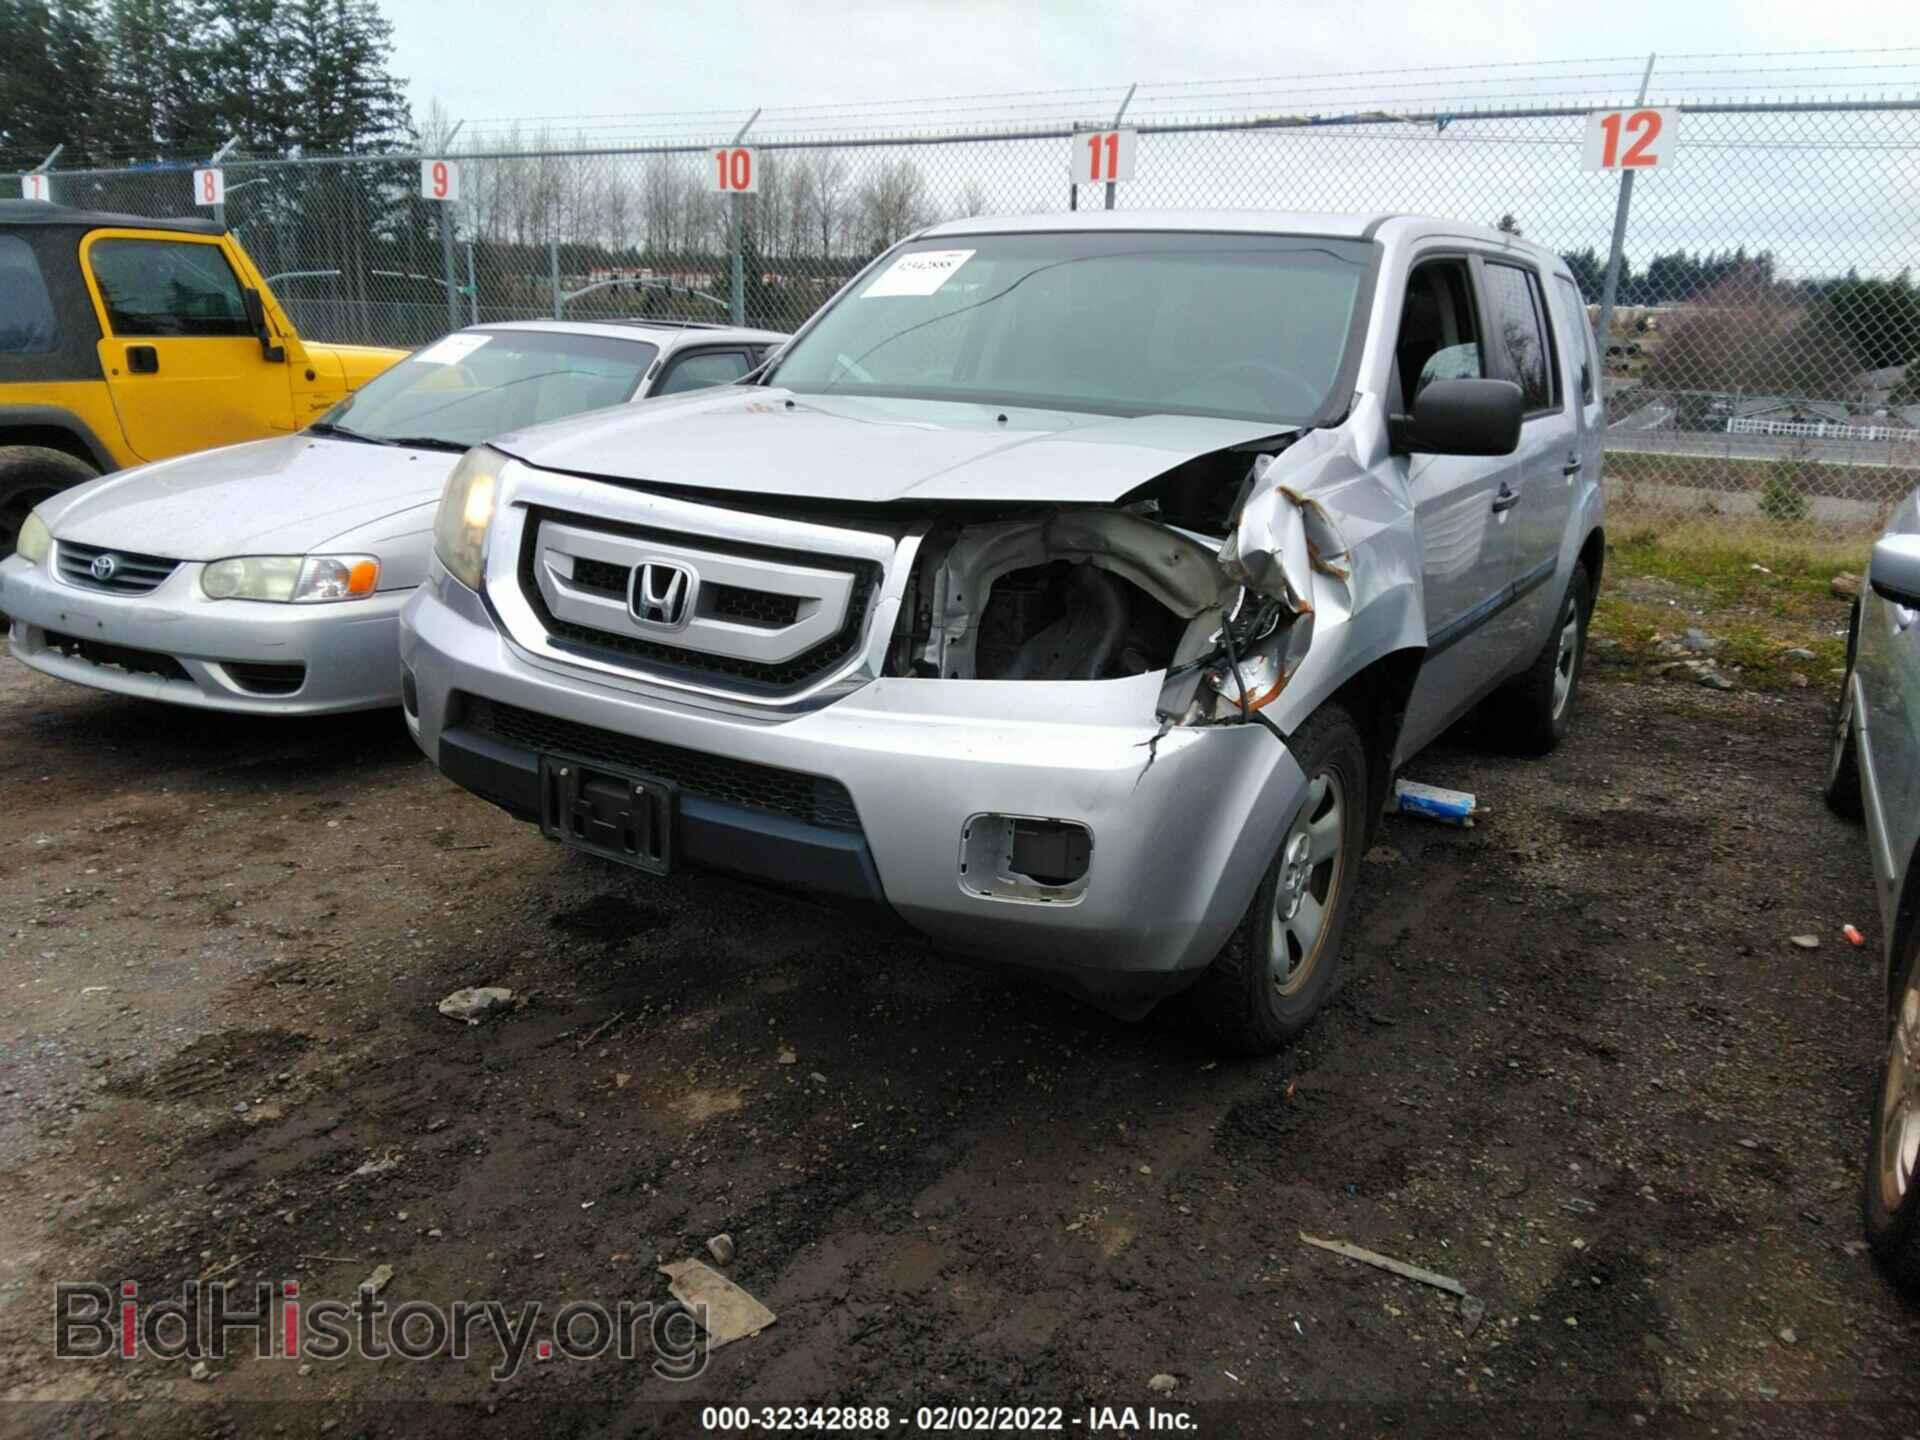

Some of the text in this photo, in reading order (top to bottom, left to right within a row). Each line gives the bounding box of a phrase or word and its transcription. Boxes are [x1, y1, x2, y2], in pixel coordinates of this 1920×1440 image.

[1088, 132, 1120, 181] 11
[1601, 109, 1663, 168] 12
[203, 170, 215, 202] 8
[432, 160, 449, 198] 9
[715, 147, 752, 191] 10
